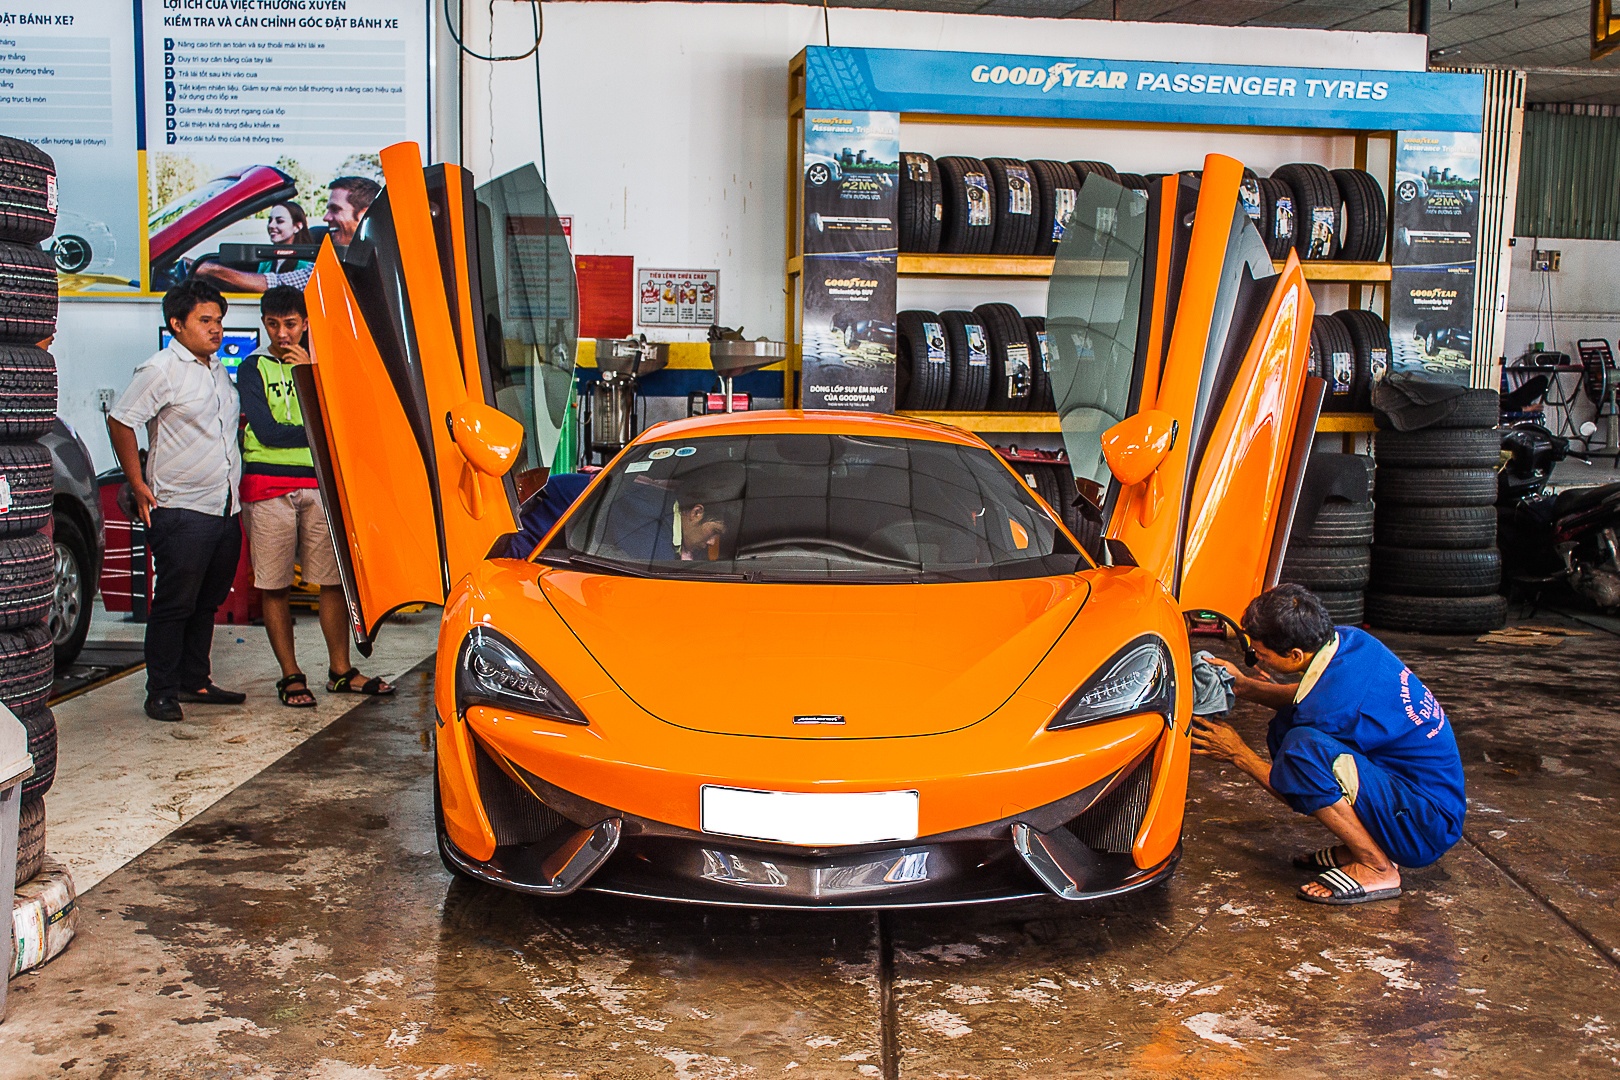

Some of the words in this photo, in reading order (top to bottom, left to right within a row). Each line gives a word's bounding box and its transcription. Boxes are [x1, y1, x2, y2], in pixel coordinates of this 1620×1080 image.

[19, 12, 52, 25] BÁNH
[54, 15, 75, 26] XE?
[163, 14, 192, 27] KIỂM
[193, 17, 216, 27] TRA
[217, 15, 232, 27] VÀ
[260, 15, 296, 28] CHỈNH
[298, 16, 323, 28] GÓC
[325, 16, 348, 31] ĐẶT
[349, 17, 382, 29] BÁNH
[384, 19, 399, 29] XE
[166, 40, 171, 48] 1
[166, 54, 172, 62] 2
[166, 68, 172, 76] 3
[971, 63, 1129, 92] GOODYEAR
[1136, 72, 1298, 98] PASSENGER
[1304, 79, 1389, 101] TYRES
[167, 87, 173, 95] 4
[168, 105, 173, 113] 5
[168, 120, 173, 128] 6
[811, 123, 855, 134] Assurance
[168, 134, 174, 142] 7
[824, 277, 879, 289] GOODYEAR
[1410, 287, 1458, 299] GOODYEAR
[838, 394, 876, 402] GOODYEAR
